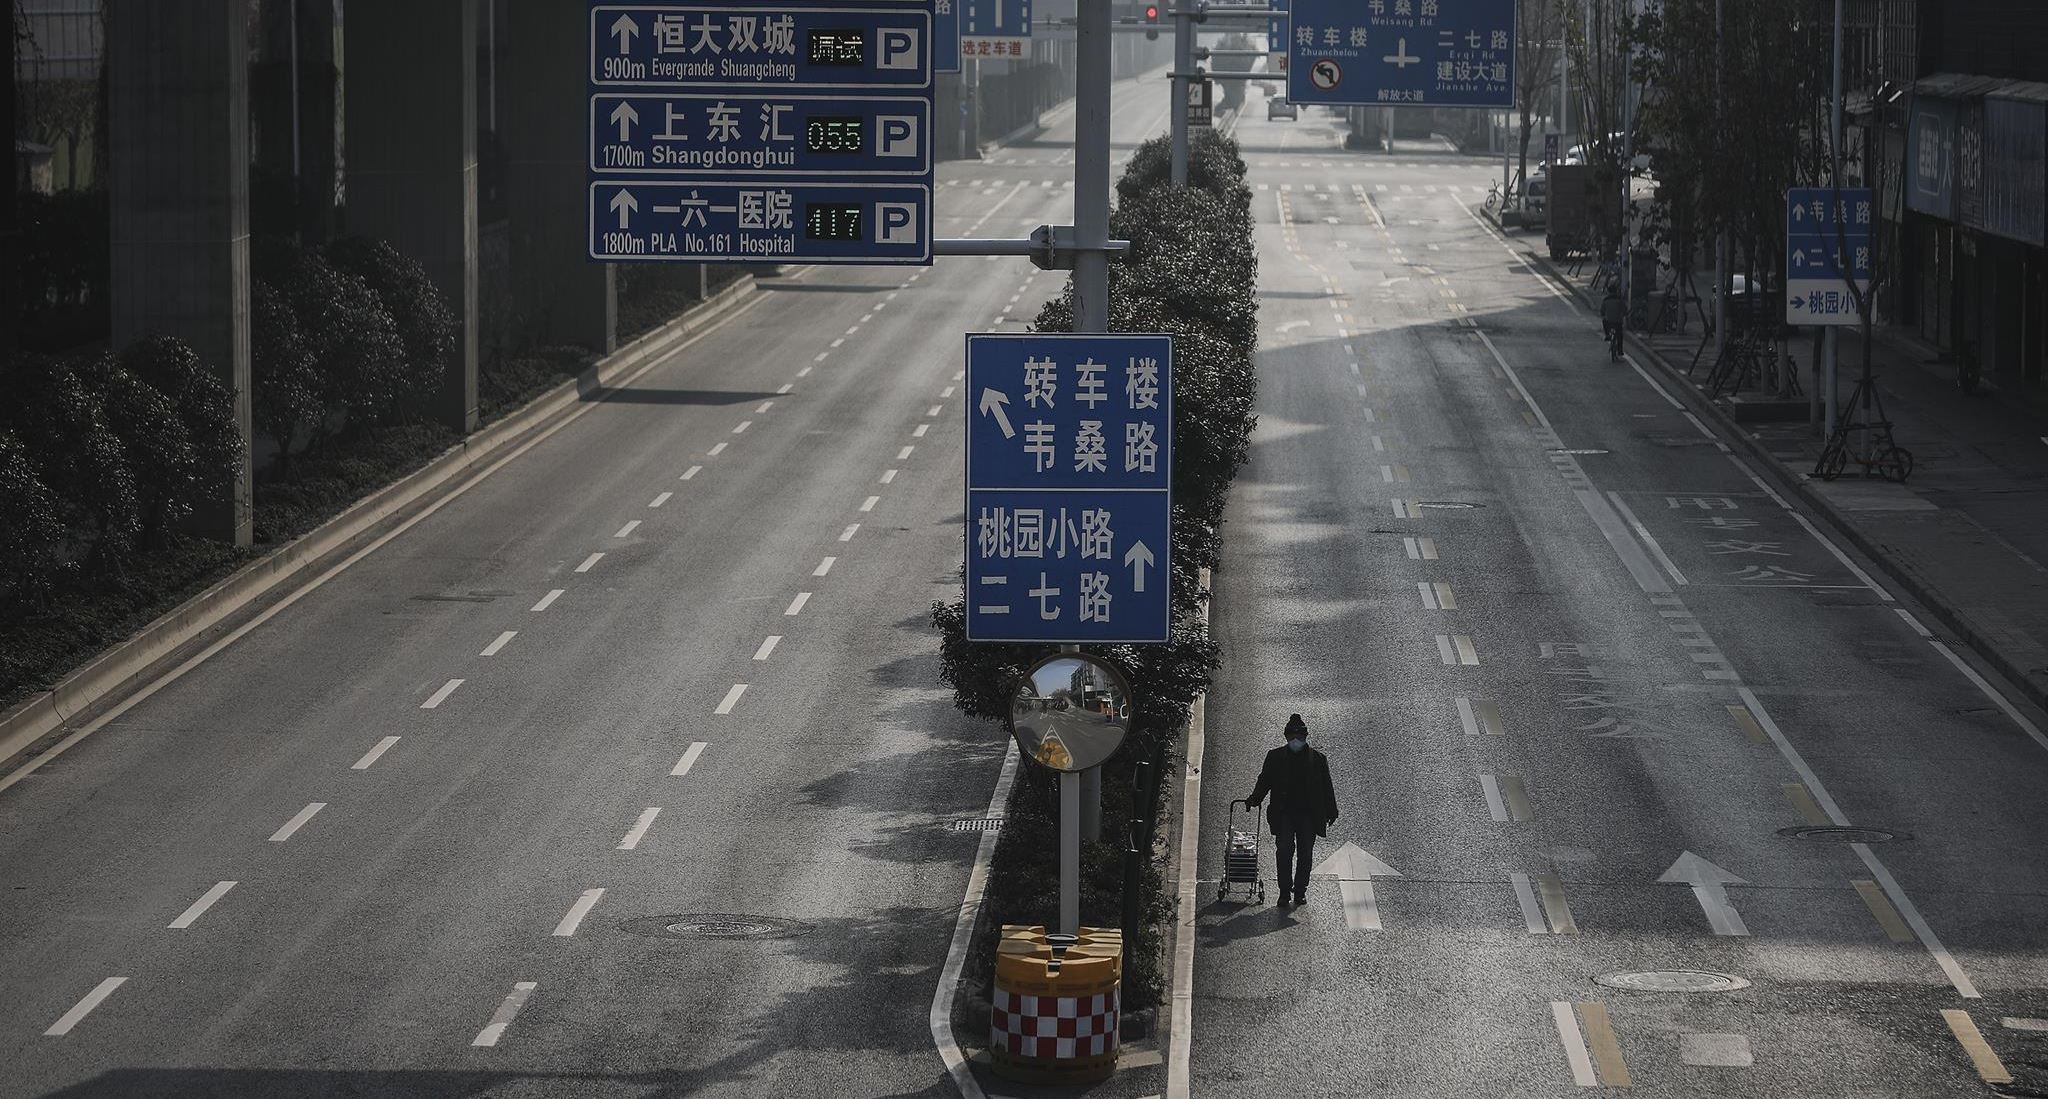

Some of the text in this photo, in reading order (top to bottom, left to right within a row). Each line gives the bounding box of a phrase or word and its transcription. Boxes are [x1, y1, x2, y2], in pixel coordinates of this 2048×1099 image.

[1371, 16, 1433, 27] Weisang Rd
[653, 14, 796, 55] 恒大双城
[1296, 26, 1368, 47] 转车楼
[1438, 30, 1508, 50] 二七路
[962, 40, 1023, 57] 选定车道
[1482, 51, 1495, 59] Rd
[604, 58, 795, 80] 900m Evergrande Shuangcheng
[1437, 61, 1508, 83] 建设大道
[1377, 89, 1424, 101] 解放大道
[1436, 83, 1478, 92] Jianshe
[652, 102, 794, 142] 上东汇
[808, 123, 860, 149] 055
[603, 146, 795, 168] 1700m Shangdonghui
[653, 190, 793, 230] 一六一医院
[603, 234, 795, 255] 1800m PLA No.161 Hospital
[1809, 291, 1866, 314] 桃园小
[1024, 356, 1158, 409] 转车楼
[1024, 420, 1158, 473] 韦桑路
[978, 507, 1114, 559] 桃园小路
[979, 571, 1113, 622] 二七路
